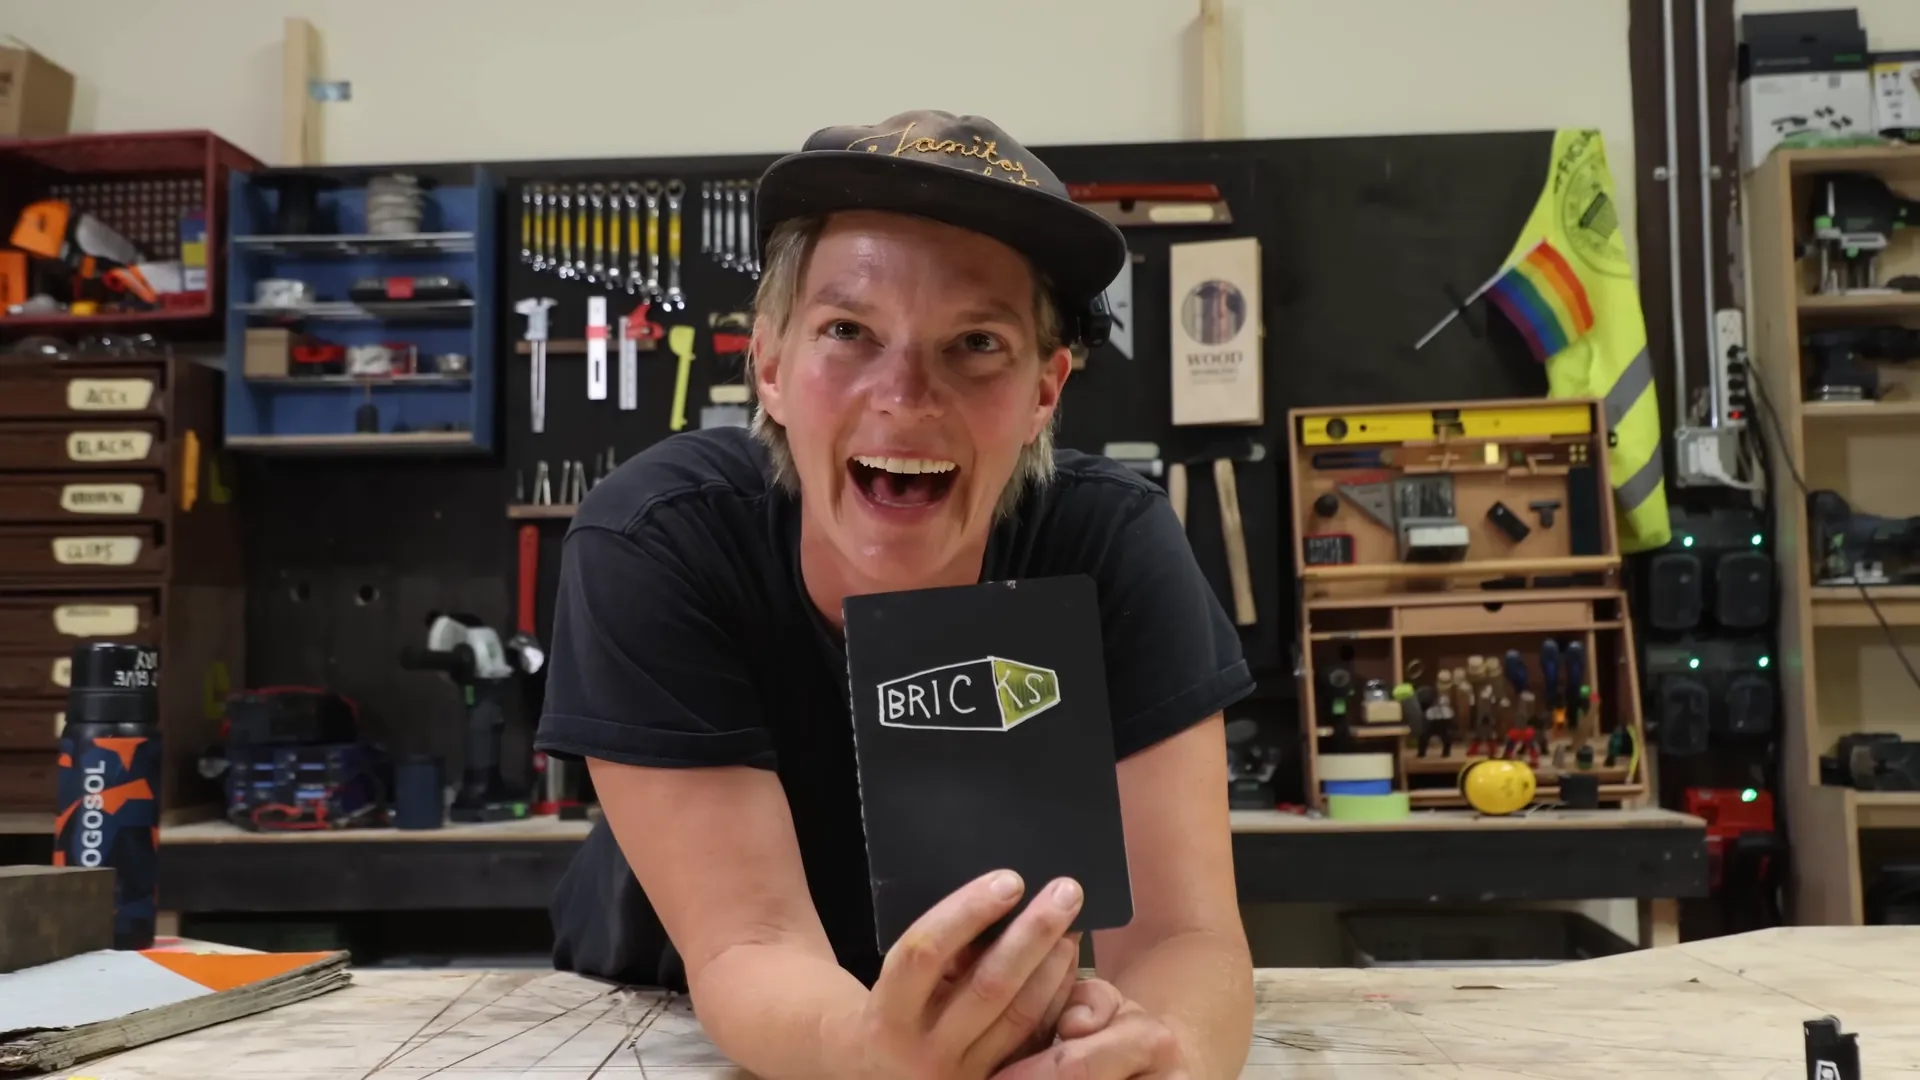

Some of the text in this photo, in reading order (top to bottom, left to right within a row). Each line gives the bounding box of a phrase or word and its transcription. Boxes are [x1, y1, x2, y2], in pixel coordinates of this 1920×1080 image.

[1186, 351, 1243, 366] WOOD
[887, 668, 1044, 721] BRICKS
[81, 759, 106, 868] OGOSOL
